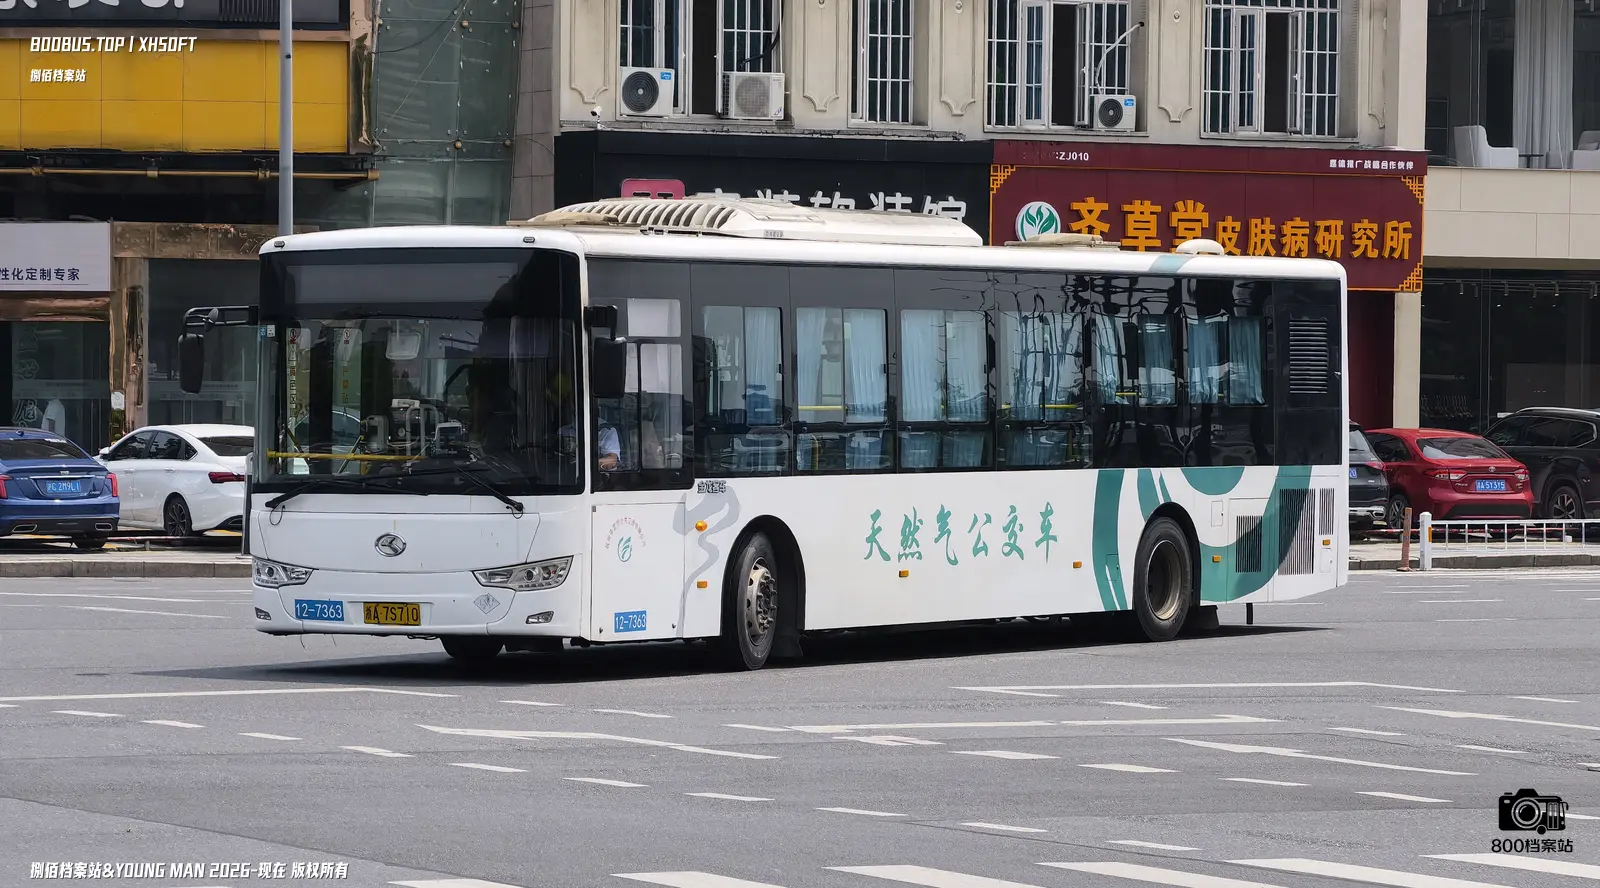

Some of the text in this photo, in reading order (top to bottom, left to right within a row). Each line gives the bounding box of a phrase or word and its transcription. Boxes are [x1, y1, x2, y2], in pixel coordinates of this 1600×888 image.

[863, 501, 1058, 566] 天然气公交车
[295, 603, 343, 619] 12-7363
[615, 613, 646, 630] 12-7363
